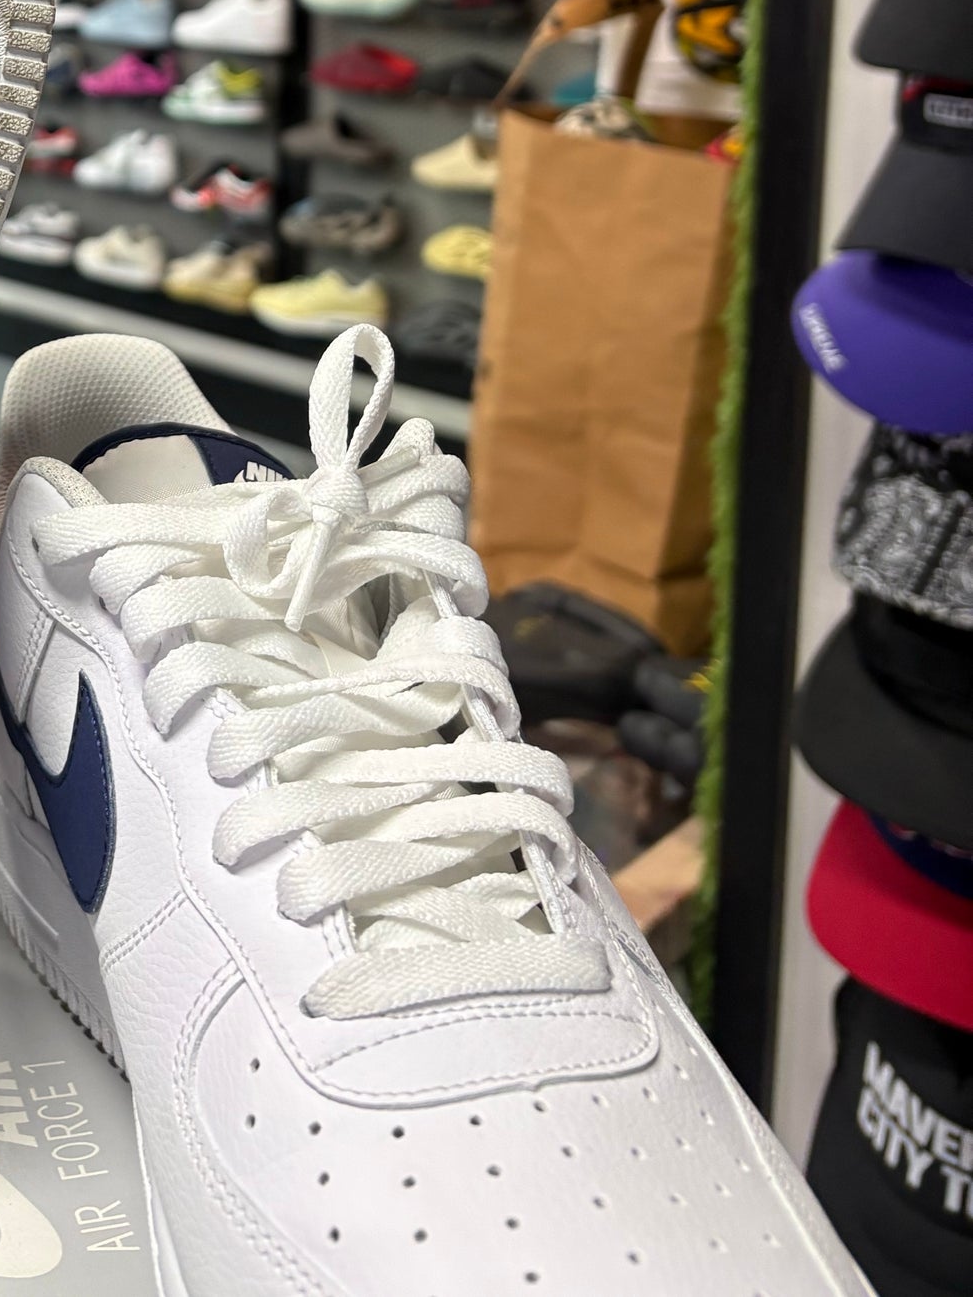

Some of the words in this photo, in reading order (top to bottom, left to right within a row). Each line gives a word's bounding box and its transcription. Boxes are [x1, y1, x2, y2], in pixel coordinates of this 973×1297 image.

[245, 460, 289, 483] NI
[29, 1081, 109, 1181] FORCE
[856, 1084, 935, 1190] CITY
[939, 1164, 973, 1221] T
[74, 1200, 141, 1252] AIR
